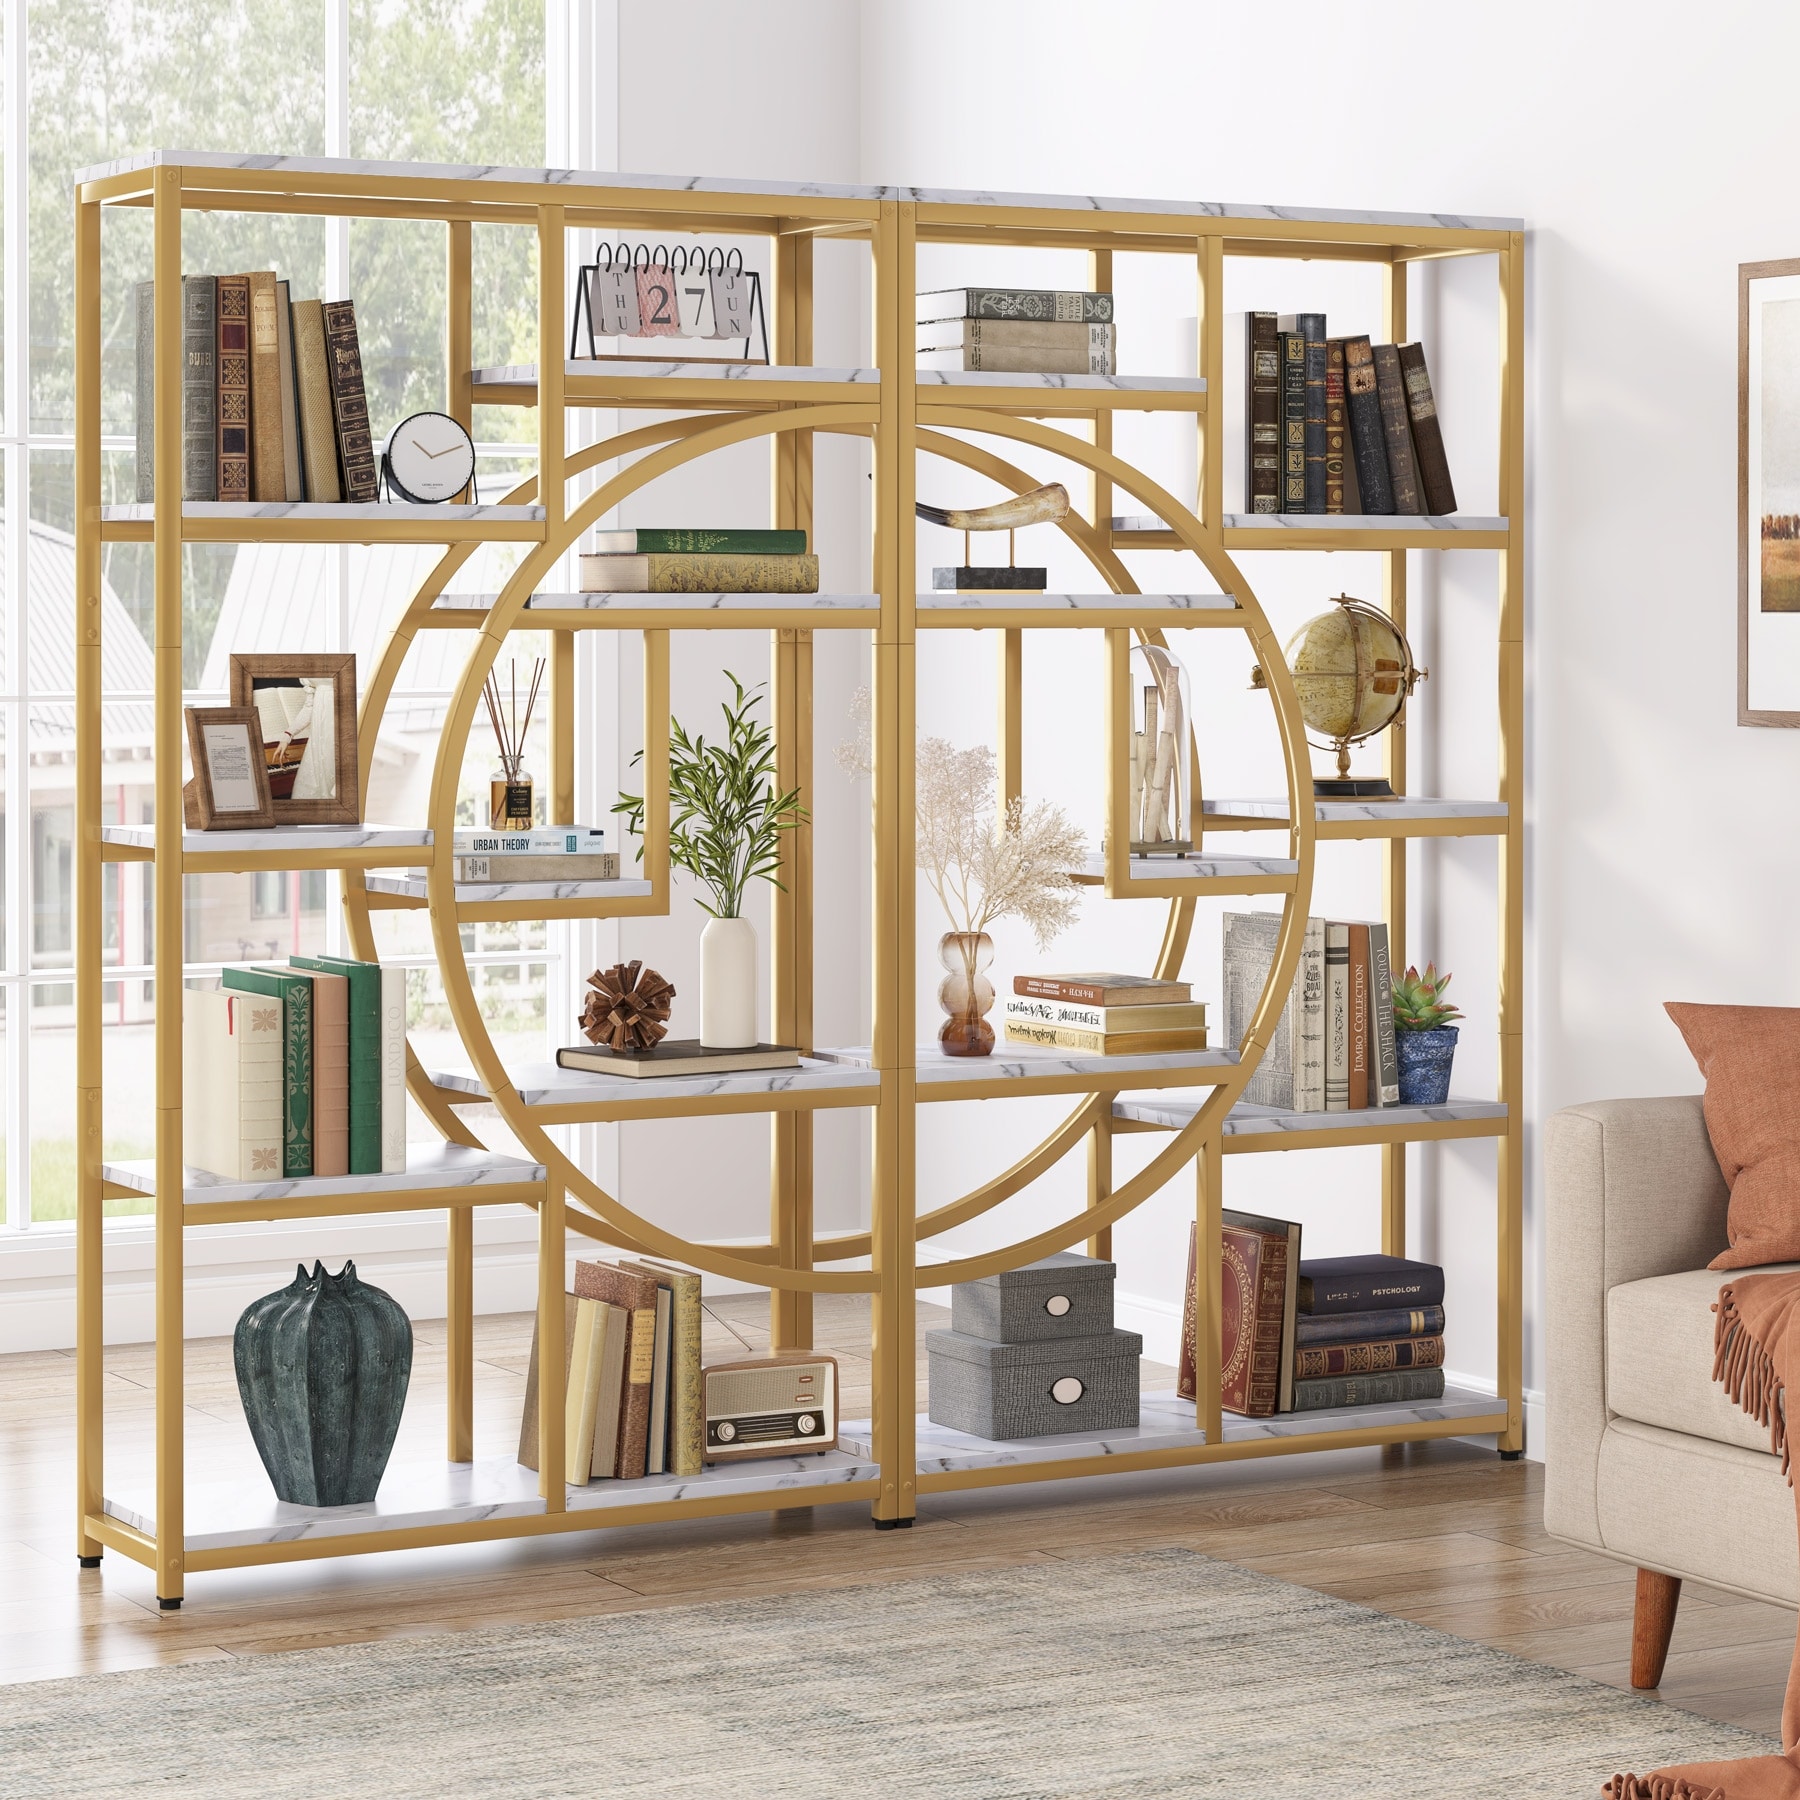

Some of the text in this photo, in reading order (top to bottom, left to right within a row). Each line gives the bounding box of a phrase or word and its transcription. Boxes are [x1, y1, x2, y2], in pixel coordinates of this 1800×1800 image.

[613, 272, 628, 330] THU
[726, 275, 741, 333] JUN
[473, 839, 499, 851] URBAN
[501, 838, 530, 851] THEORY
[1353, 964, 1366, 1073] JUMBO COLLECTION
[1376, 945, 1394, 1071] YOUNG THE SHACK
[1372, 1285, 1421, 1296] PSYCHOLOGY
